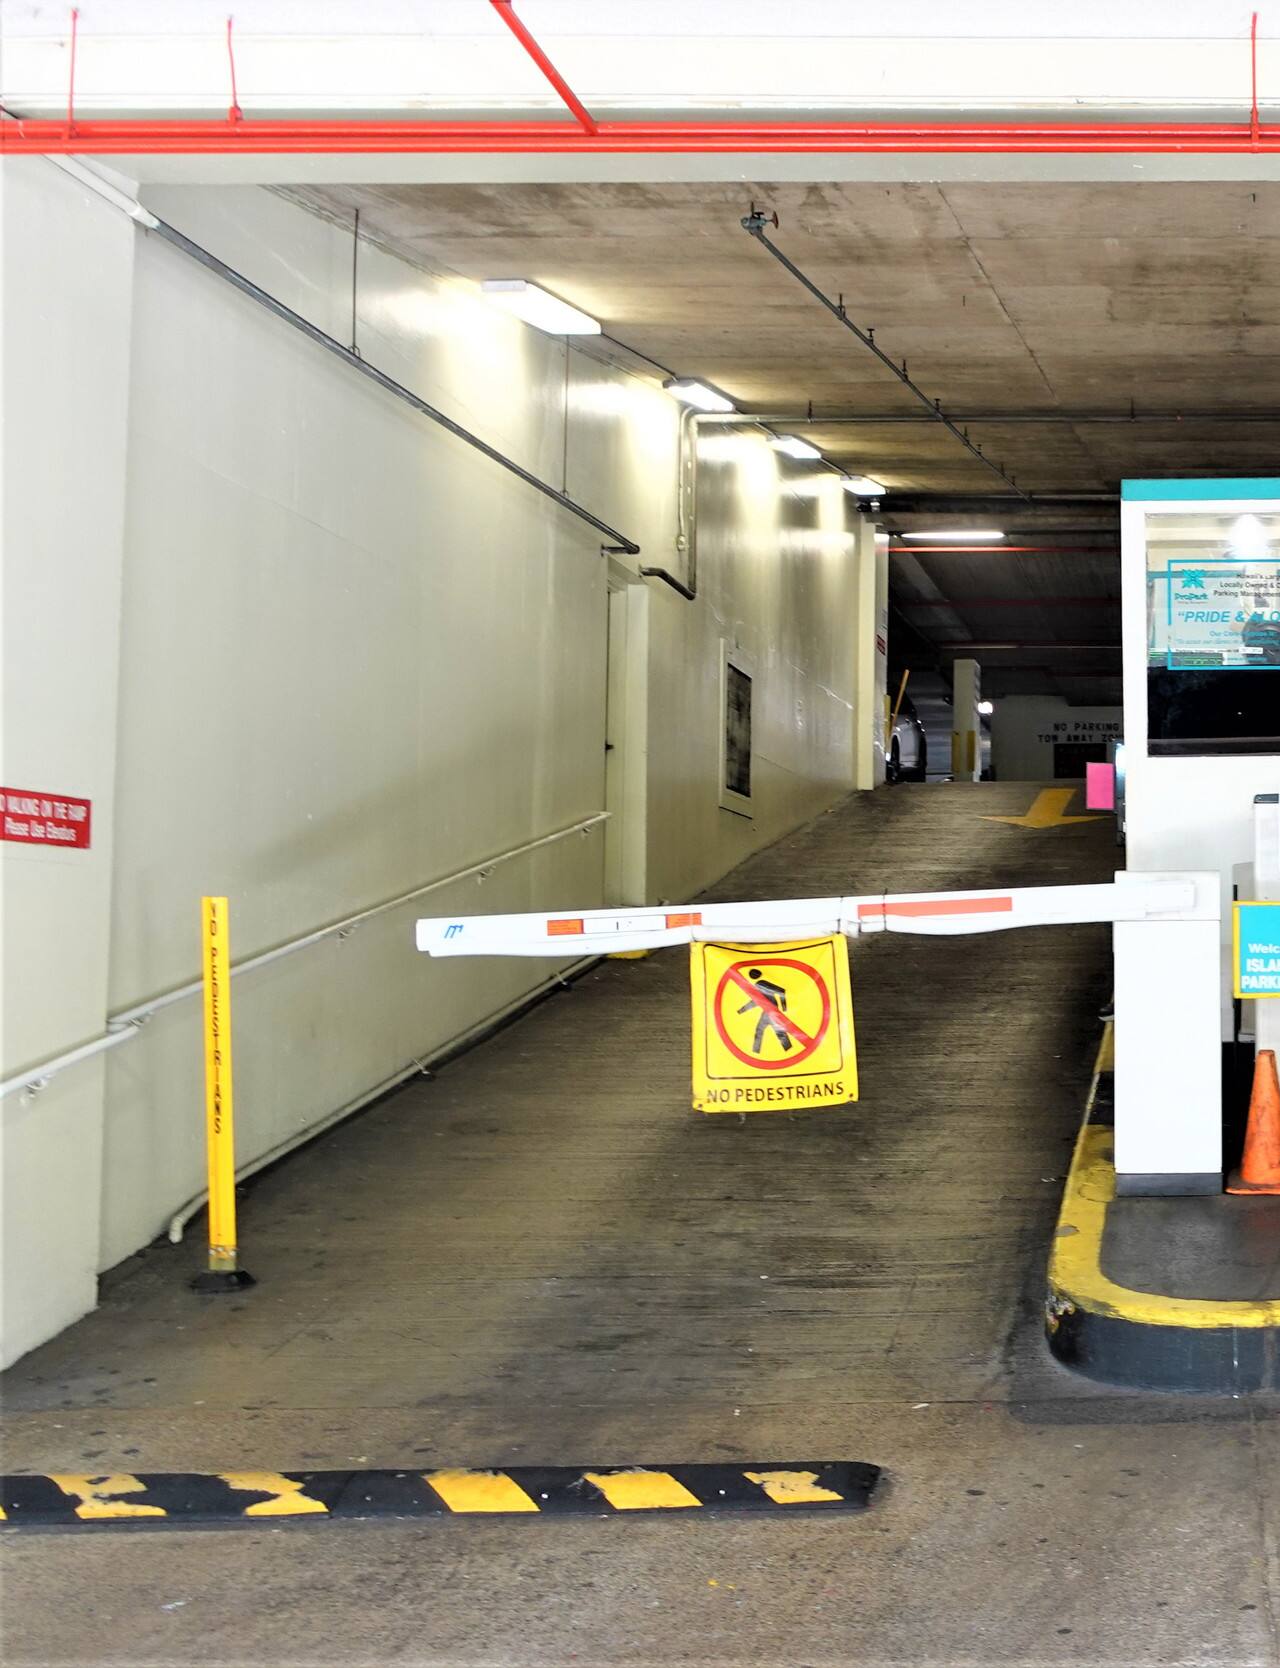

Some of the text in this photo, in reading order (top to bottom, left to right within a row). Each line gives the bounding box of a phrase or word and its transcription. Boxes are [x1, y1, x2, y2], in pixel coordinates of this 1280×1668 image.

[1220, 582, 1244, 590] Locally
[1213, 590, 1238, 598] Parking
[1240, 590, 1280, 599] Management
[1234, 610, 1246, 623] &
[1053, 722, 1119, 732] NO PARKING
[1038, 734, 1058, 743] TOW
[1066, 734, 1093, 742] AWAY
[6, 795, 40, 816] WALKING
[40, 799, 53, 818] ON
[53, 801, 68, 820] THE
[68, 803, 87, 823] RAMP
[4, 816, 77, 842] Please Use Elevators
[707, 1082, 844, 1103] NO PEDESTRIANS
